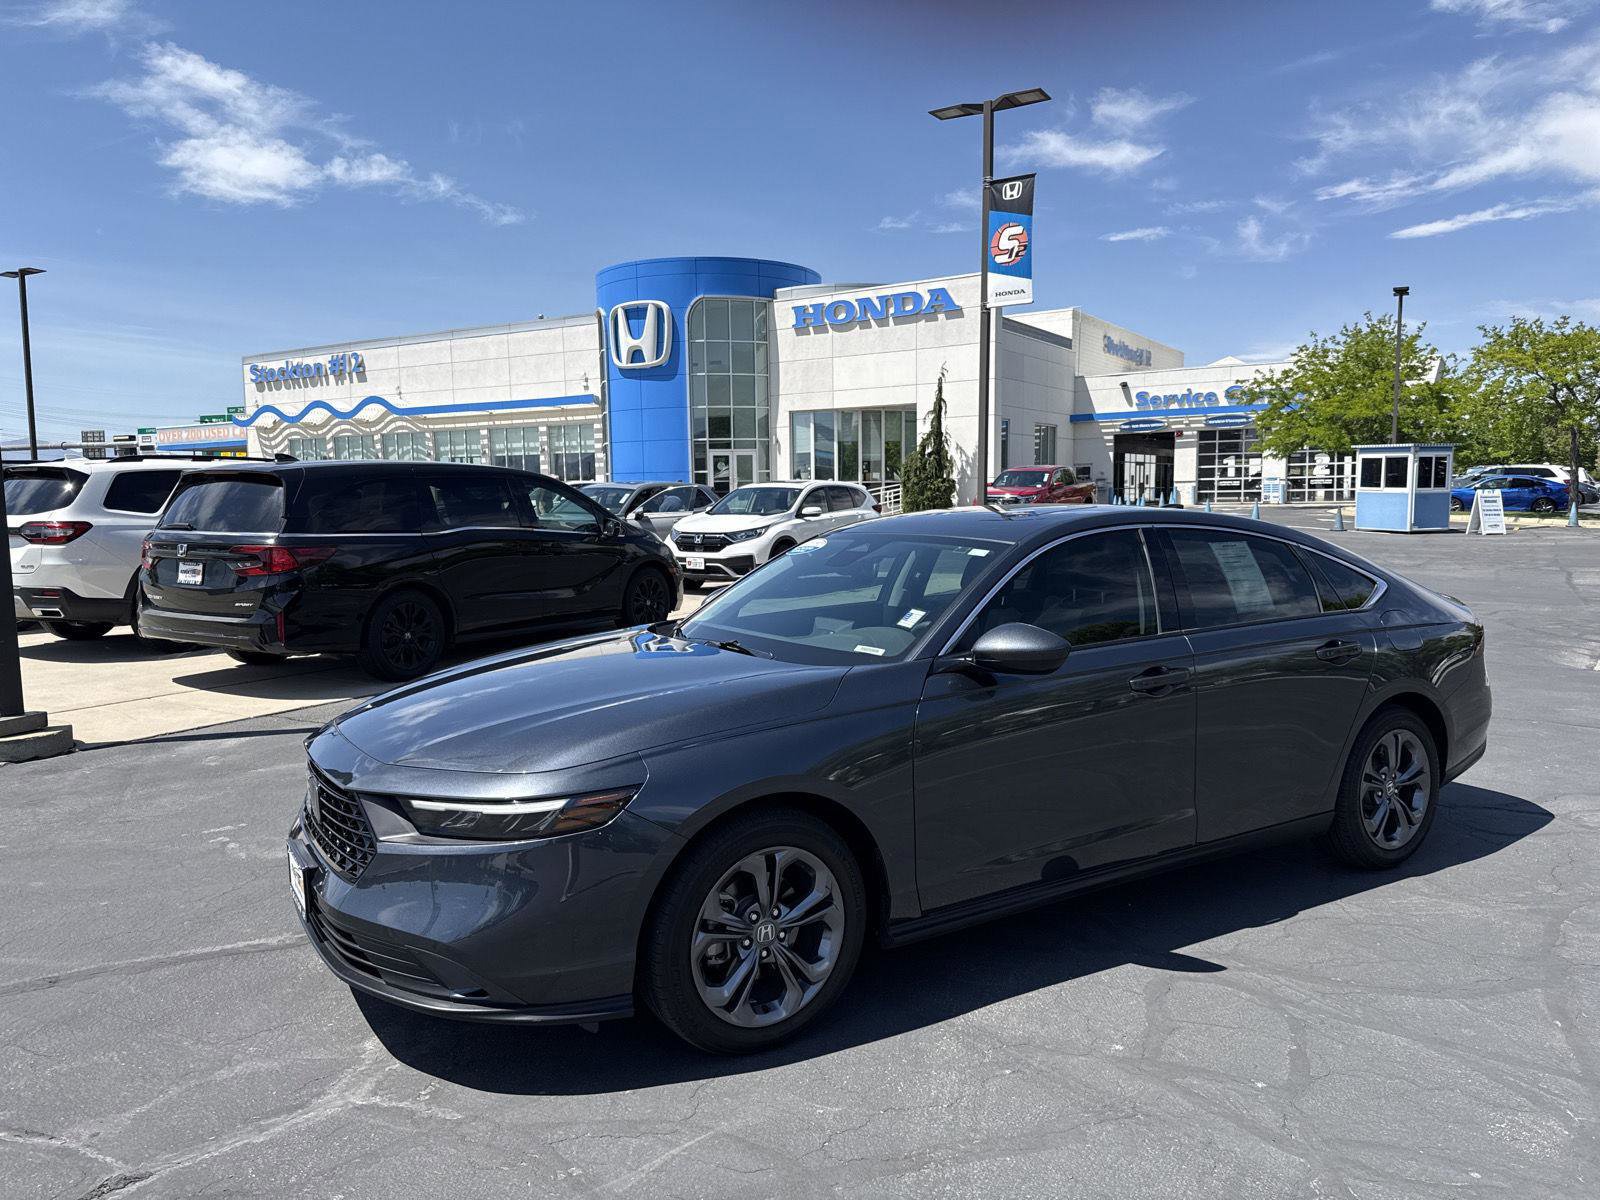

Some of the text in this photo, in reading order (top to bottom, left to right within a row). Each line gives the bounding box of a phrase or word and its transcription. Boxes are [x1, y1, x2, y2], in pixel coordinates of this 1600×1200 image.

[995, 289, 1026, 297] HONDA
[792, 287, 962, 328] HONDA
[249, 352, 363, 383] Stockton #12
[1135, 388, 1219, 409] Service
[158, 430, 183, 442] OVER
[204, 426, 229, 440] USED
[1223, 455, 1235, 477] 1
[1313, 453, 1330, 476] 2
